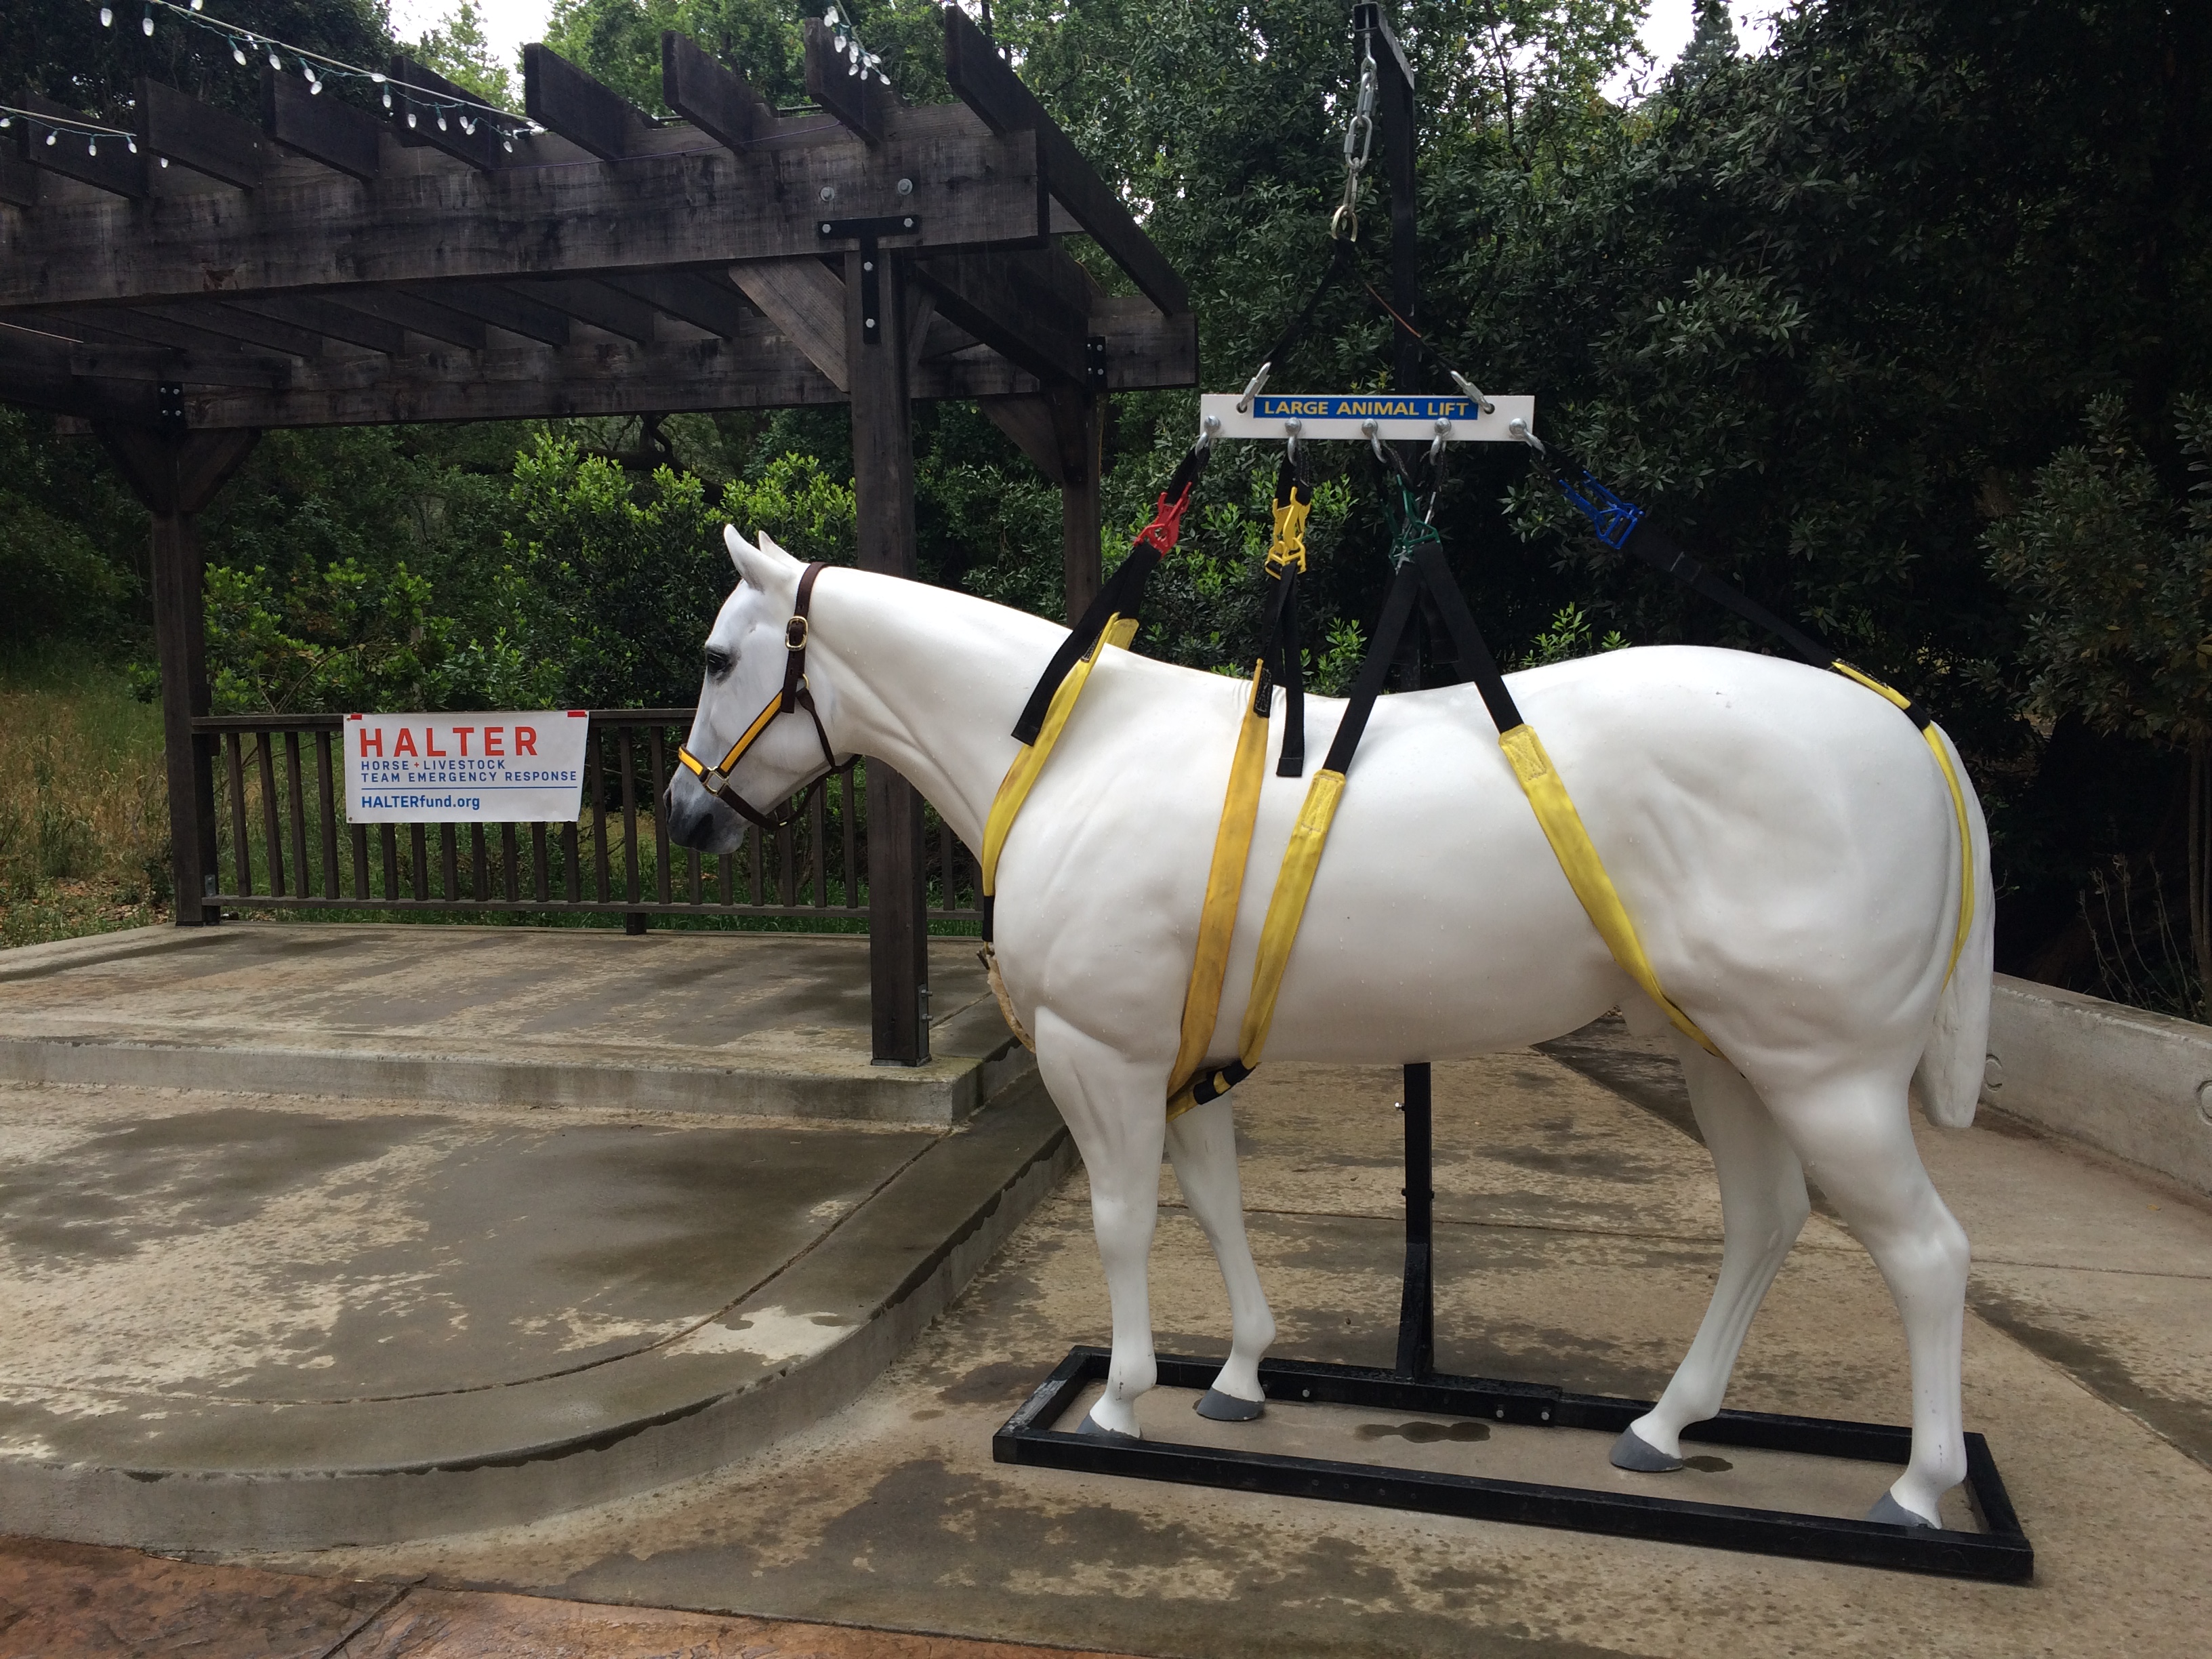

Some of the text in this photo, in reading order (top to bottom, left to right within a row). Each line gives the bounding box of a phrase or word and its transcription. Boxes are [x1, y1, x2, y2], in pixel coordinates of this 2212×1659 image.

[1264, 401, 1469, 416] LARGE ANIMAL LIFT
[360, 726, 537, 757] HALTER
[361, 760, 409, 771] HORSE
[424, 760, 506, 770] LIVESTOCK
[361, 771, 577, 782] TEAM EMERGENCY RESPONSE
[361, 795, 480, 810] HALTERfund.org
